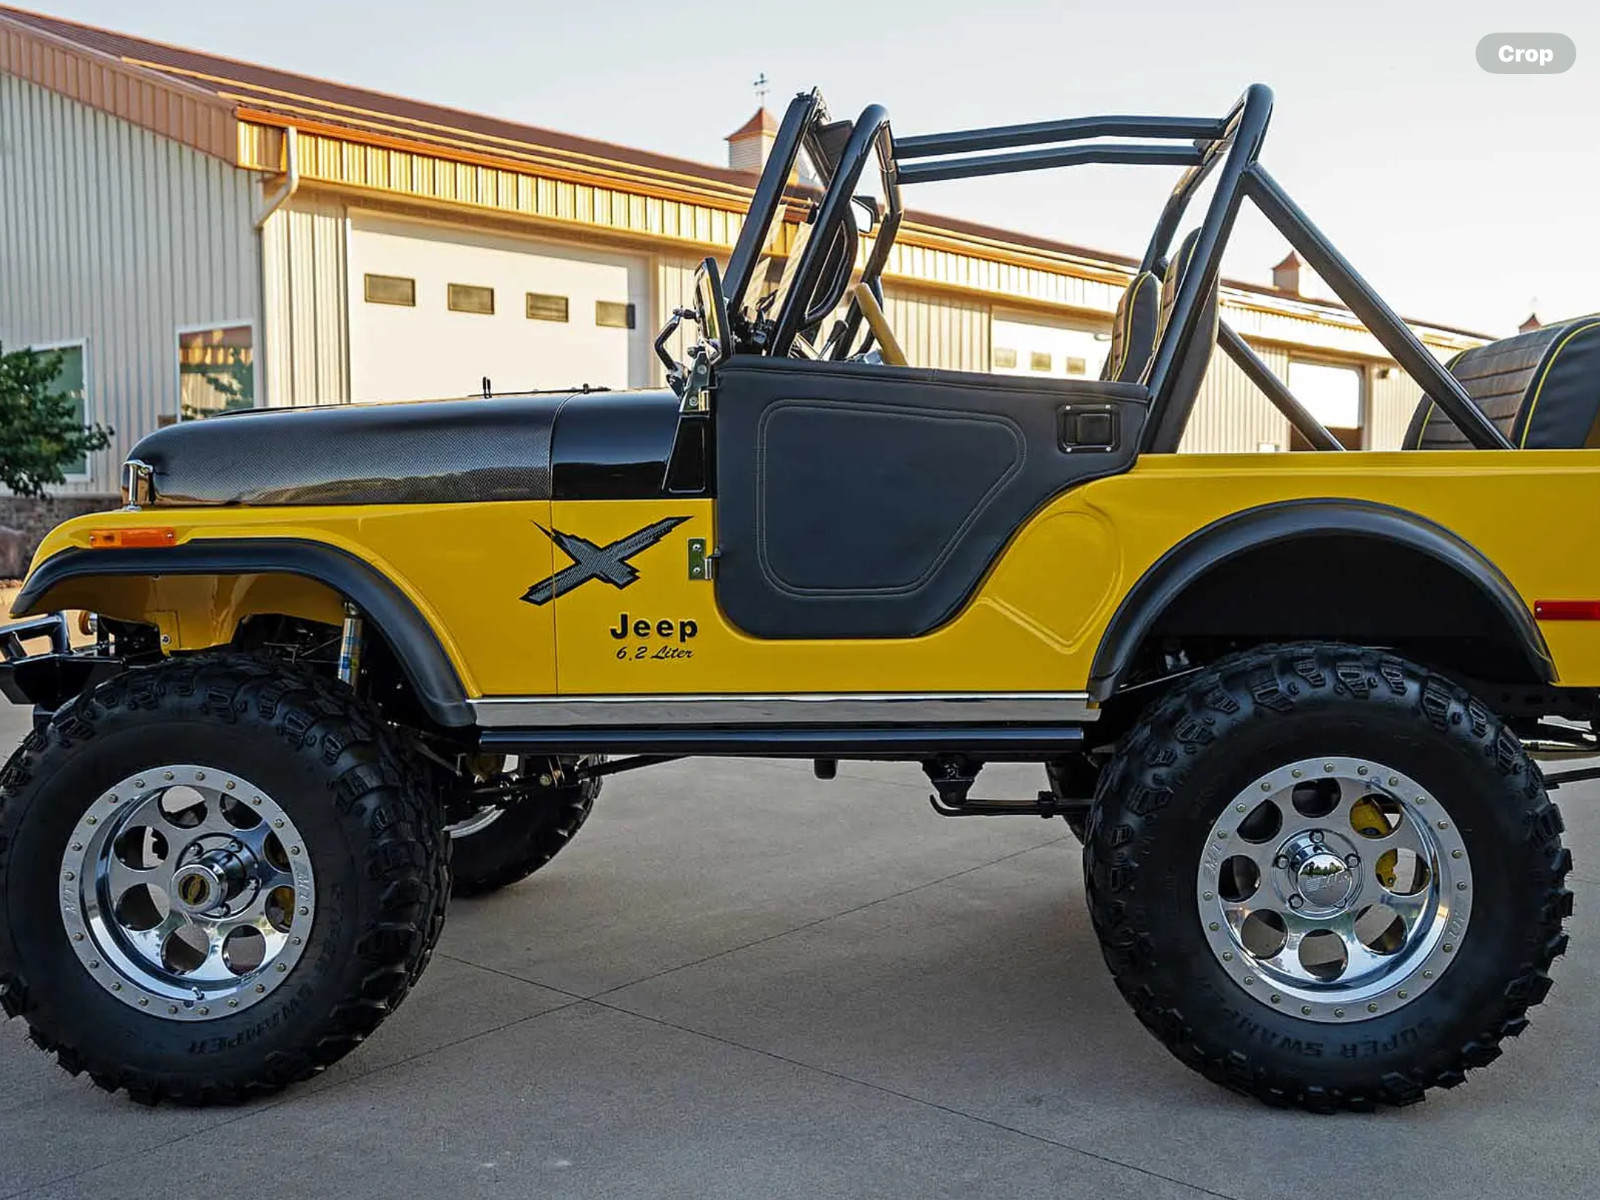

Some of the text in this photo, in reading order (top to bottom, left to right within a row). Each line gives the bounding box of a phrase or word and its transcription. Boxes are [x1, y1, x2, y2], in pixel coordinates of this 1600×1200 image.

[610, 614, 698, 643] Jeep
[616, 645, 694, 661] 6.2 Liter
